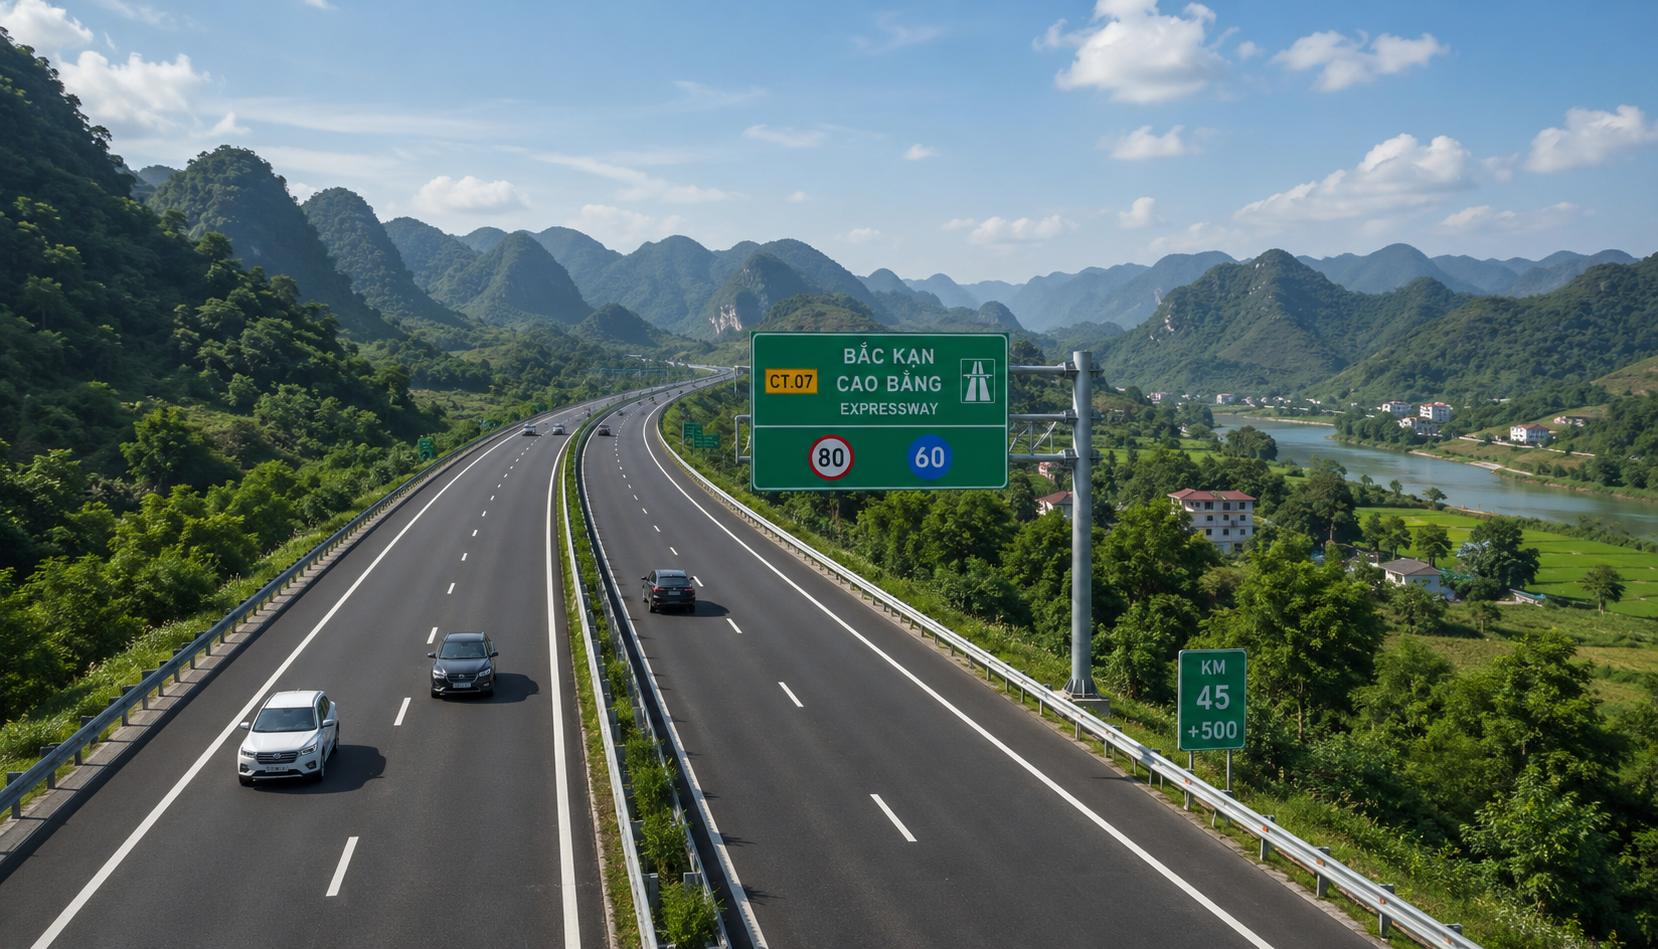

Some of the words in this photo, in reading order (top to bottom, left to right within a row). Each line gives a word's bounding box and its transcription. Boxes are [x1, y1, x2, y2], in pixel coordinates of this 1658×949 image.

[844, 342, 884, 364] BẮC
[893, 348, 934, 368] KẠN
[770, 374, 812, 388] CT.07
[836, 376, 878, 392] CAO
[887, 369, 942, 392] BẰNG
[840, 403, 938, 415] EXPRESSWAY
[818, 448, 844, 467] 80
[915, 447, 944, 468] 60
[1201, 660, 1225, 675] KM
[1197, 685, 1230, 710] 45
[1188, 721, 1237, 739] +500
